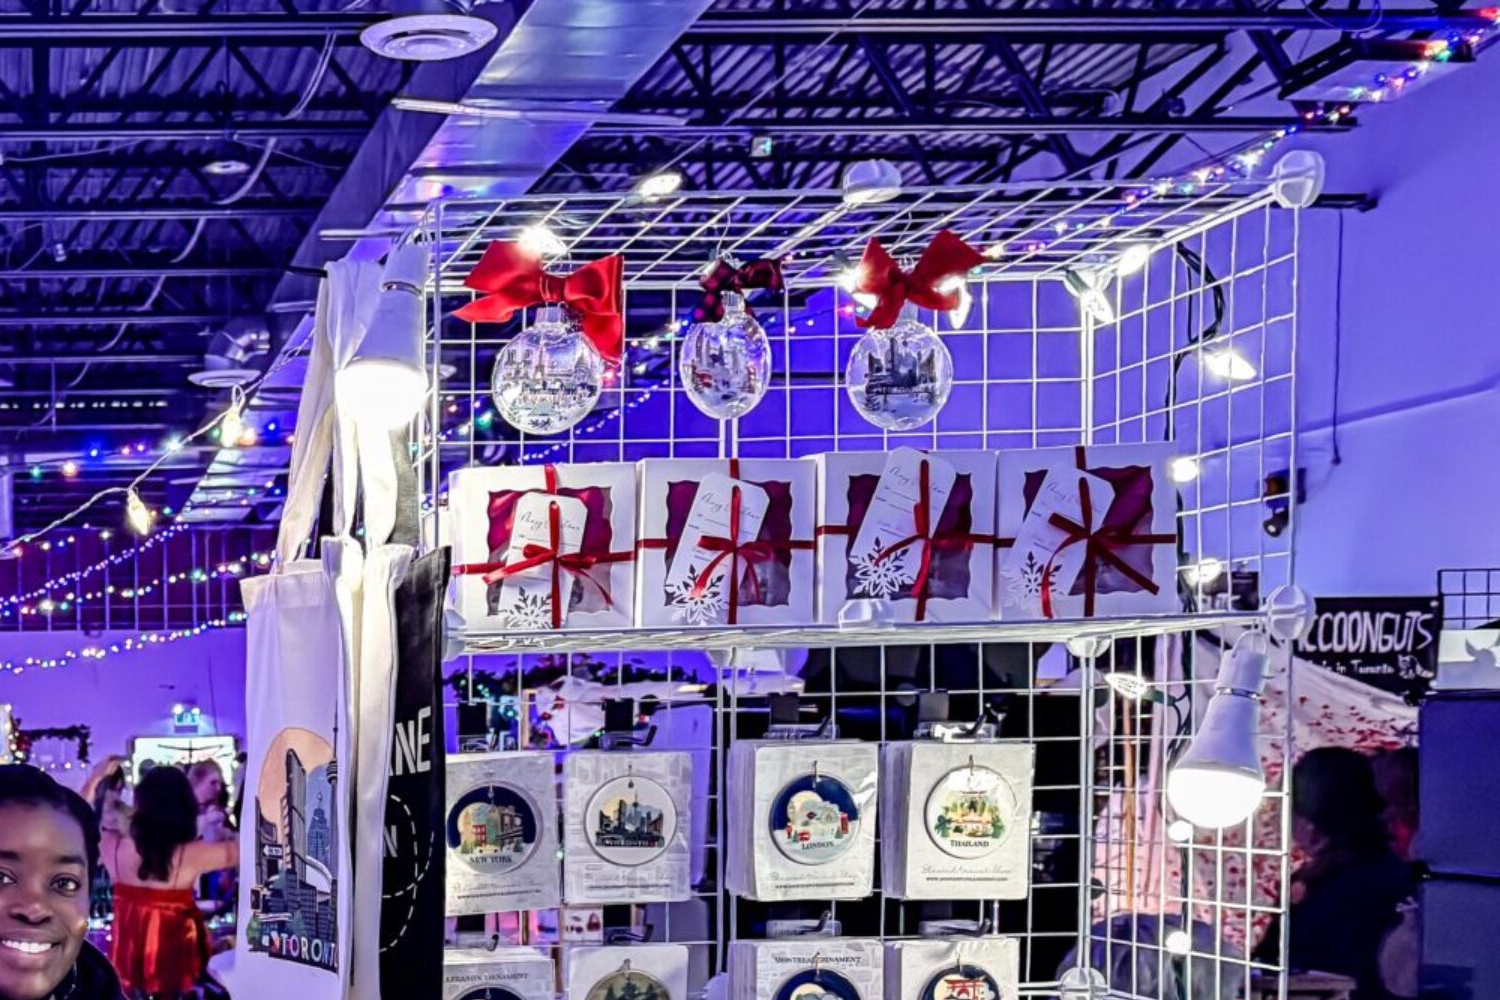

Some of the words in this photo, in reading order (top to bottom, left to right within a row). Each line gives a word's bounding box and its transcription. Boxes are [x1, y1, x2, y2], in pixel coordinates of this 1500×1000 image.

[1350, 659, 1395, 675] Toronto
[388, 705, 432, 777] NE
[801, 841, 835, 850] LONDON
[949, 838, 990, 848] THAILAND
[774, 956, 816, 965] MONTREA
